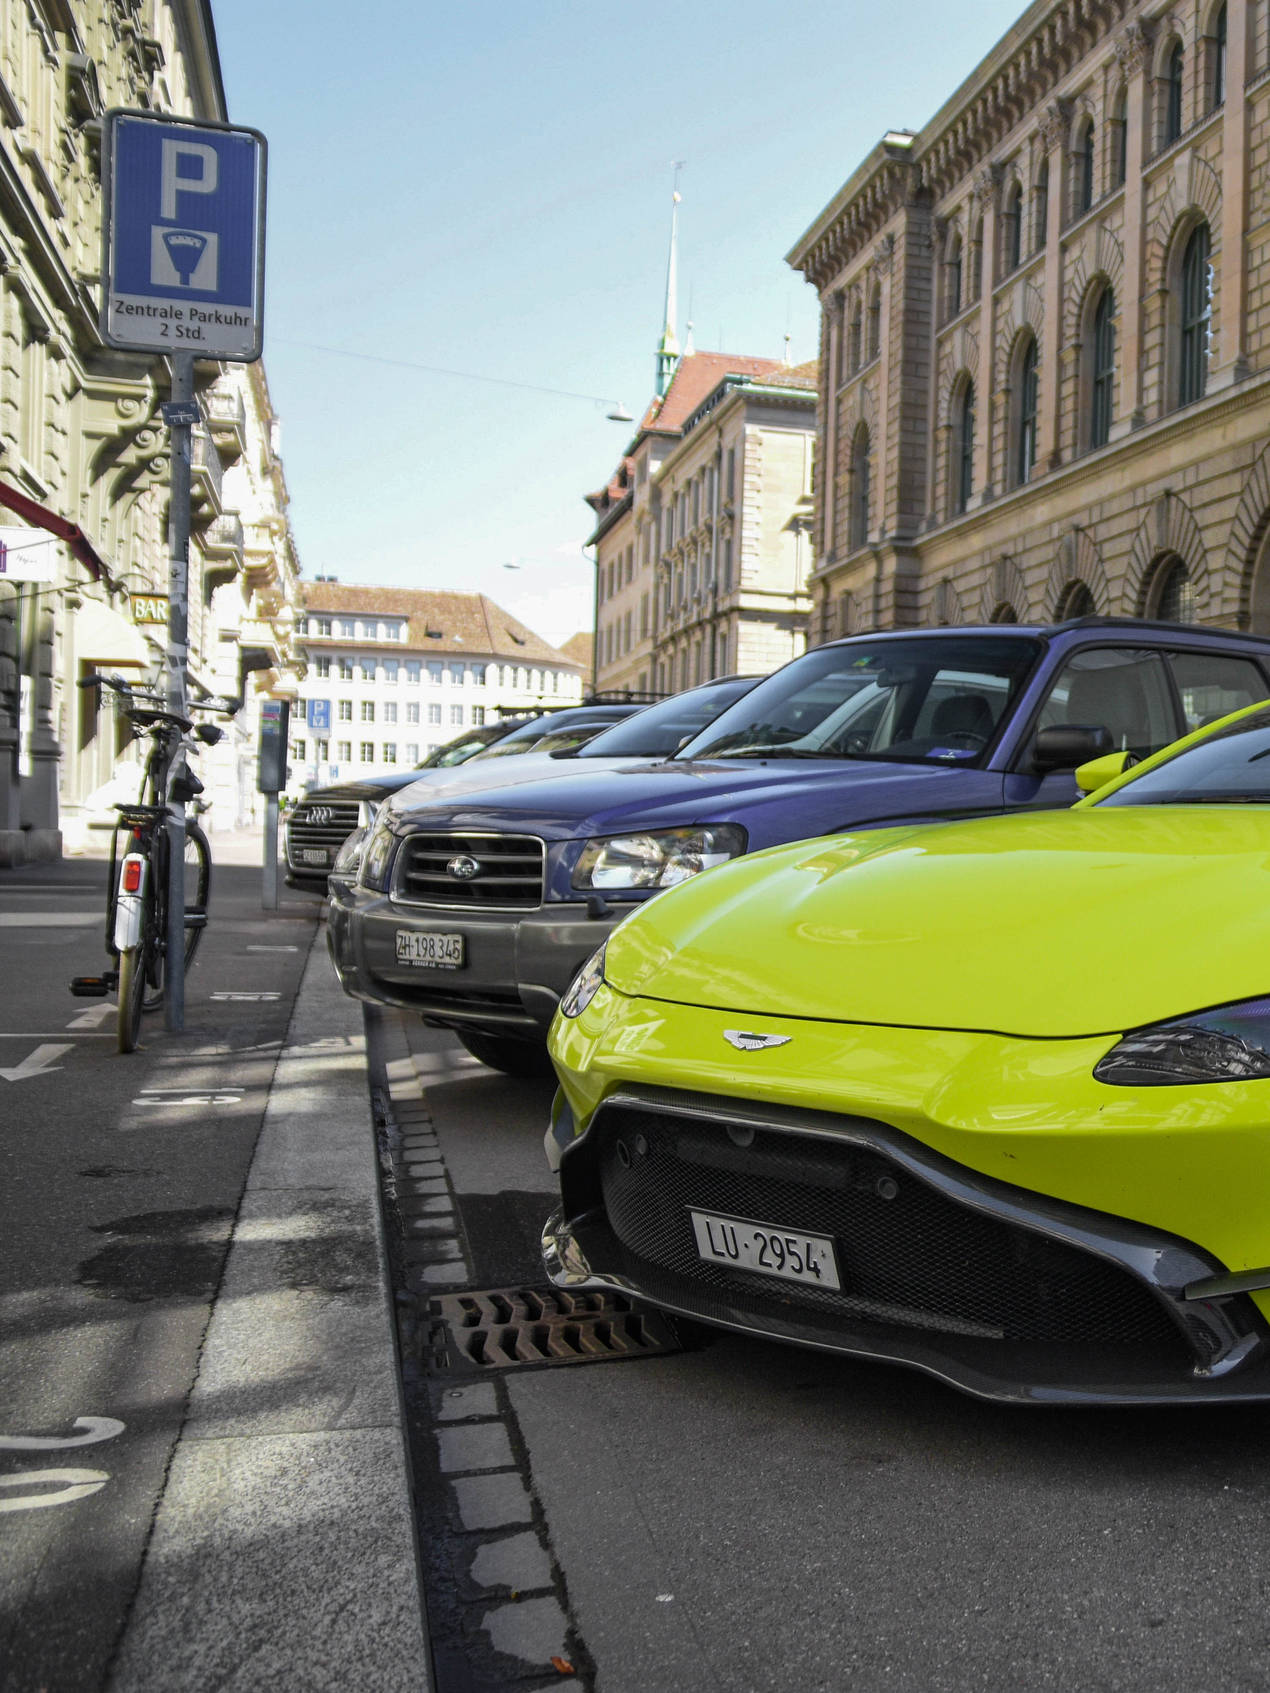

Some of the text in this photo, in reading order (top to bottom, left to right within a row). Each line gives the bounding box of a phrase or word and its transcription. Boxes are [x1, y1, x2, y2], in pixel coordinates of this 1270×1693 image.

[160, 138, 218, 220] P
[114, 300, 250, 327] Zentrale Parkuhr
[160, 323, 206, 341] 2 Std.
[134, 598, 168, 620] BAR
[314, 701, 324, 715] P
